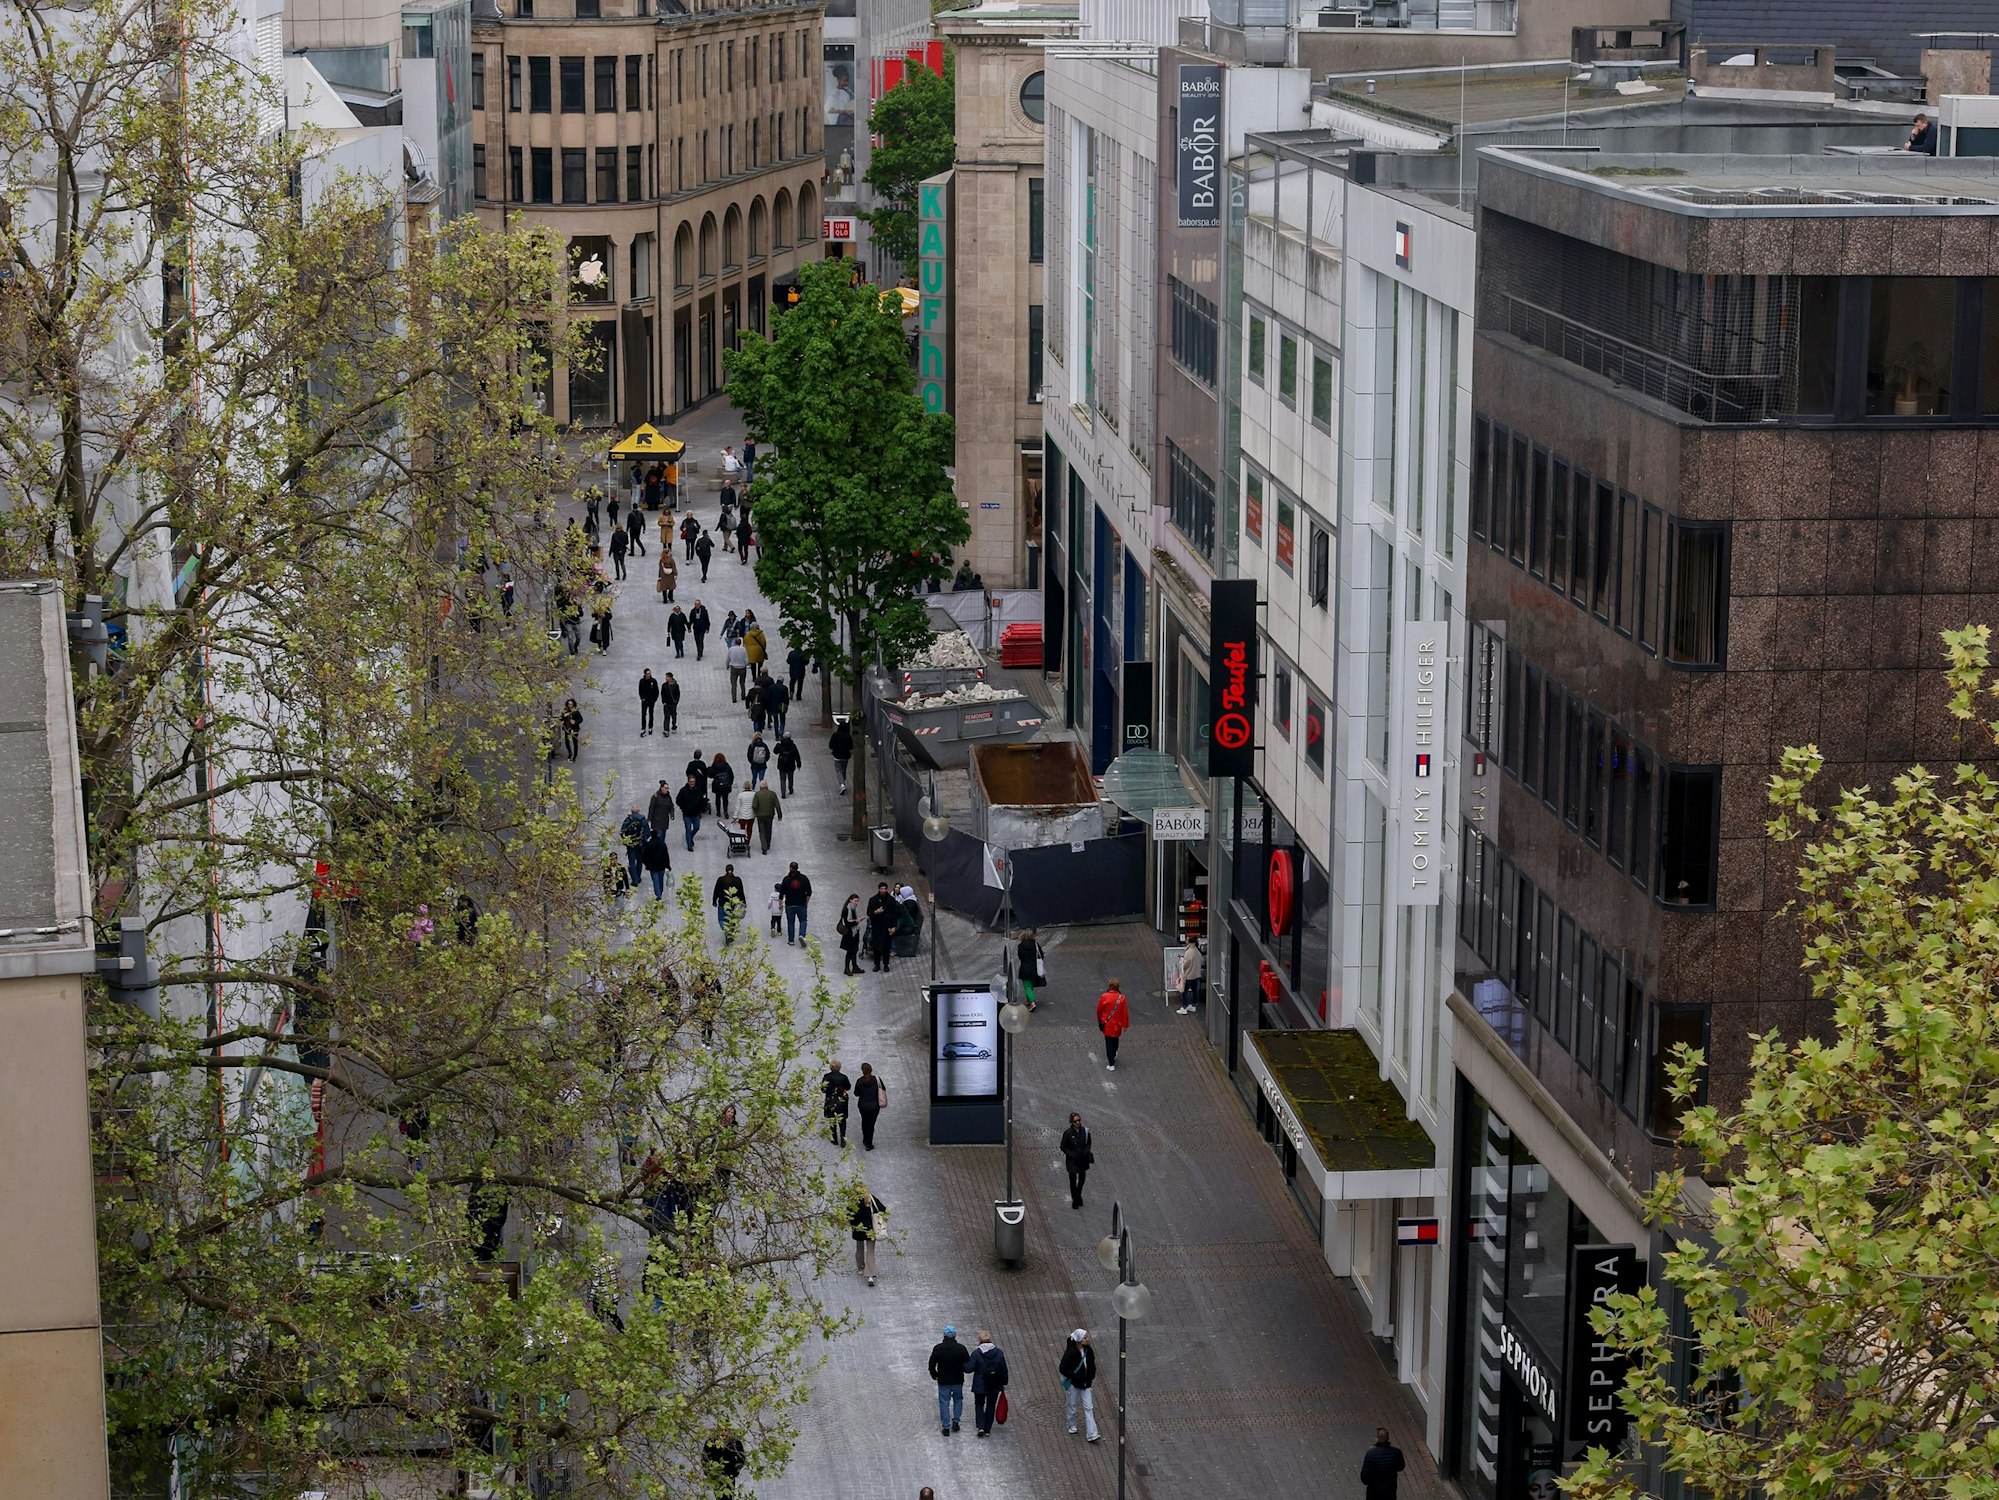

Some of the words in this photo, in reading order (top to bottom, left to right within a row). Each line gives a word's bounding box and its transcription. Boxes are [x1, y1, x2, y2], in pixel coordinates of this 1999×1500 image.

[1182, 81, 1220, 92] BABOR
[1192, 115, 1216, 208] BABOR
[1222, 641, 1249, 710] Teufel
[1416, 640, 1435, 746] HILFIGER
[1156, 819, 1202, 831] BABOR
[1412, 787, 1430, 889] TOMMY
[1500, 1324, 1556, 1422] SEPHORA
[1588, 1256, 1619, 1433] SEPHRA
